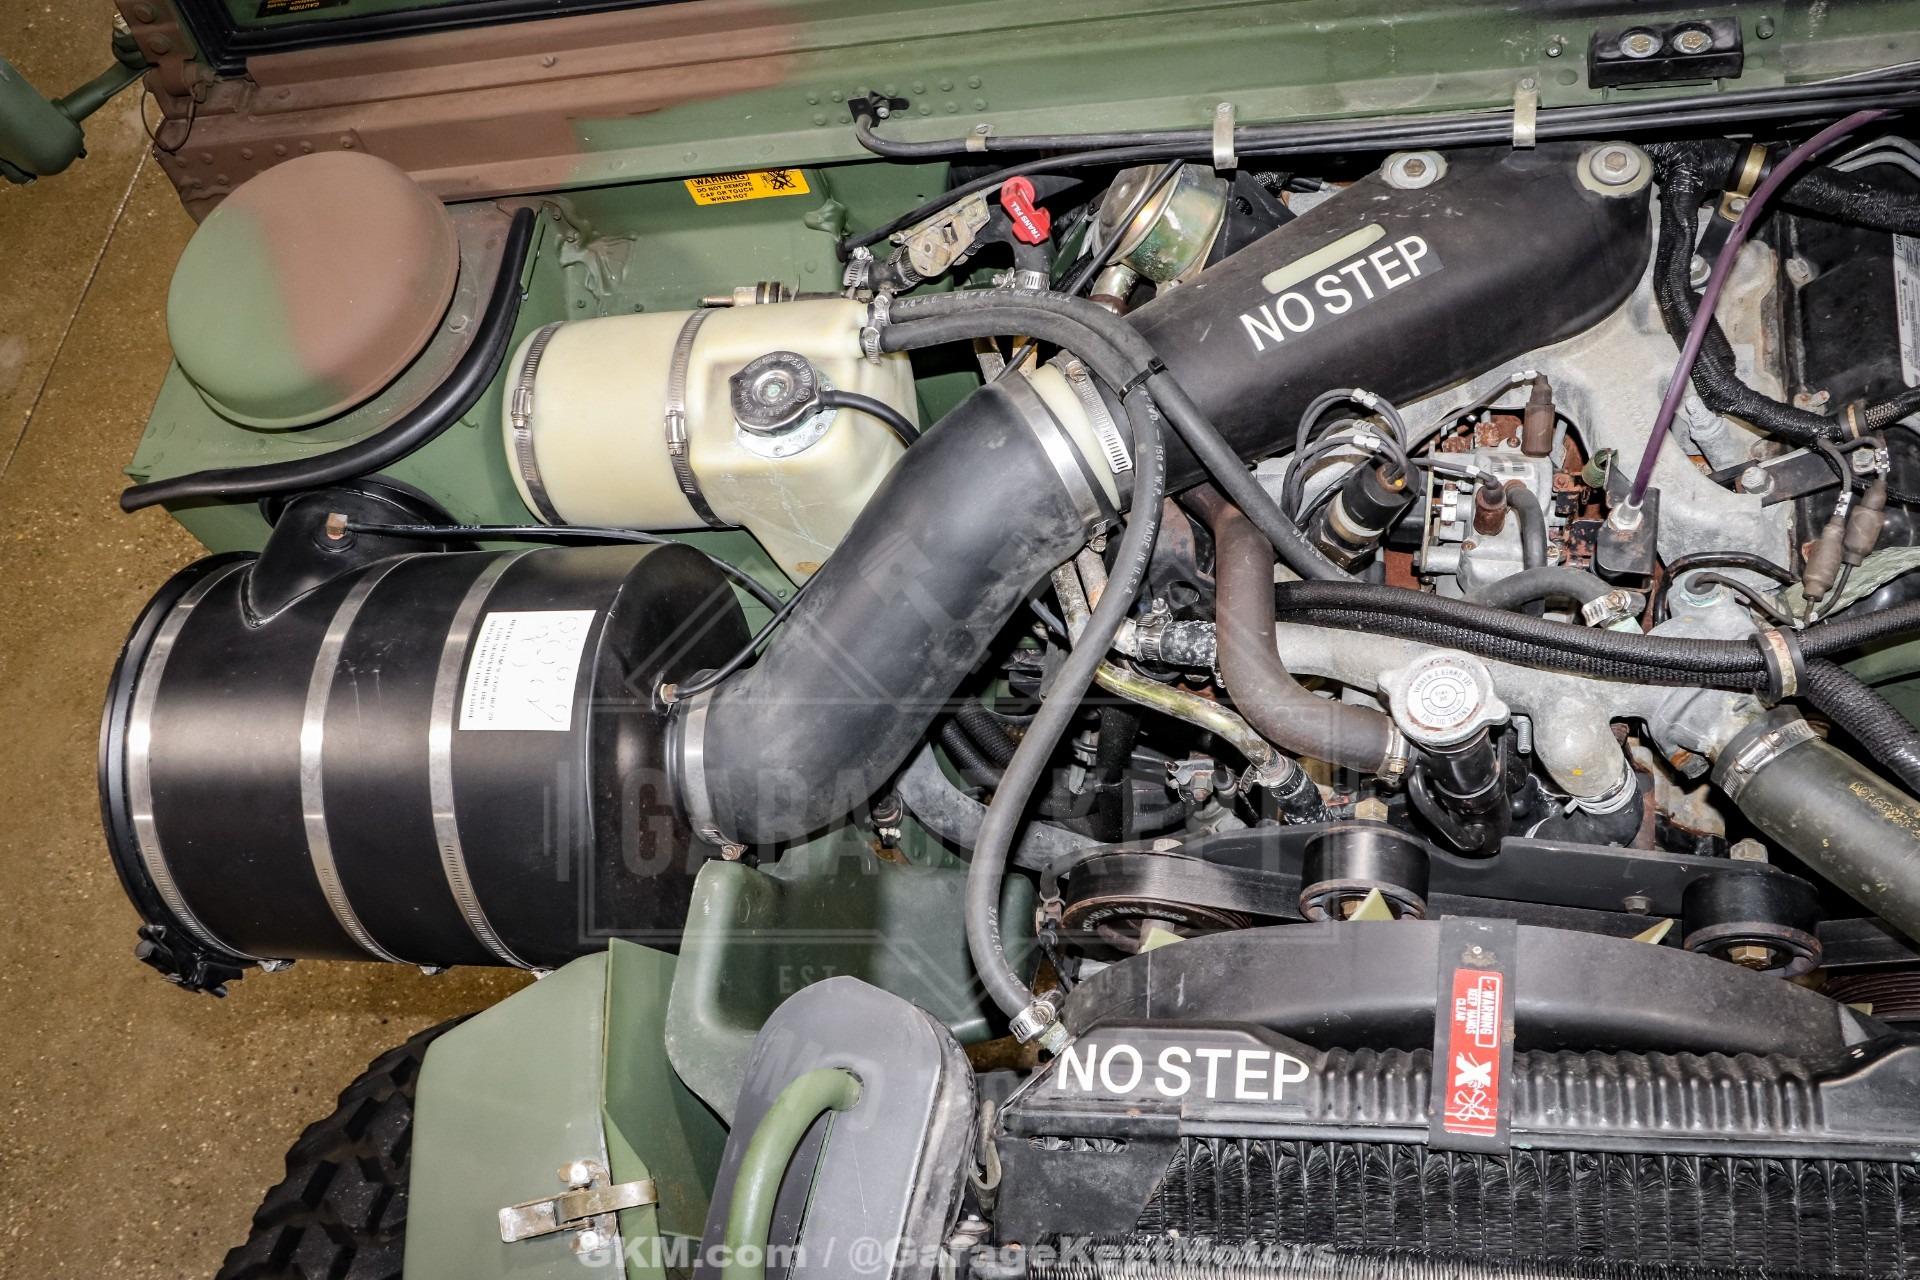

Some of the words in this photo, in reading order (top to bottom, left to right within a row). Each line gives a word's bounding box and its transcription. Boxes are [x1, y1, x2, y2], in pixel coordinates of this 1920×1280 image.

[695, 174, 746, 186] WARNING
[724, 182, 752, 190] REMOVE
[1011, 200, 1024, 217] FILL
[1020, 215, 1041, 240] TRANS
[1013, 289, 1033, 297] MADE
[1239, 292, 1315, 351] NO
[1315, 235, 1428, 315] STEP
[1154, 445, 1164, 461] 150
[1152, 475, 1163, 497] W.P.
[1142, 521, 1156, 549] MADE
[1136, 552, 1146, 565] IN
[1466, 988, 1478, 1006] KEEP
[1455, 997, 1466, 1021] CLEAR
[1480, 990, 1495, 1034] WARNING
[1465, 1009, 1477, 1034] HANDS
[1057, 1044, 1143, 1094] NO
[1155, 1046, 1310, 1101] STEP
